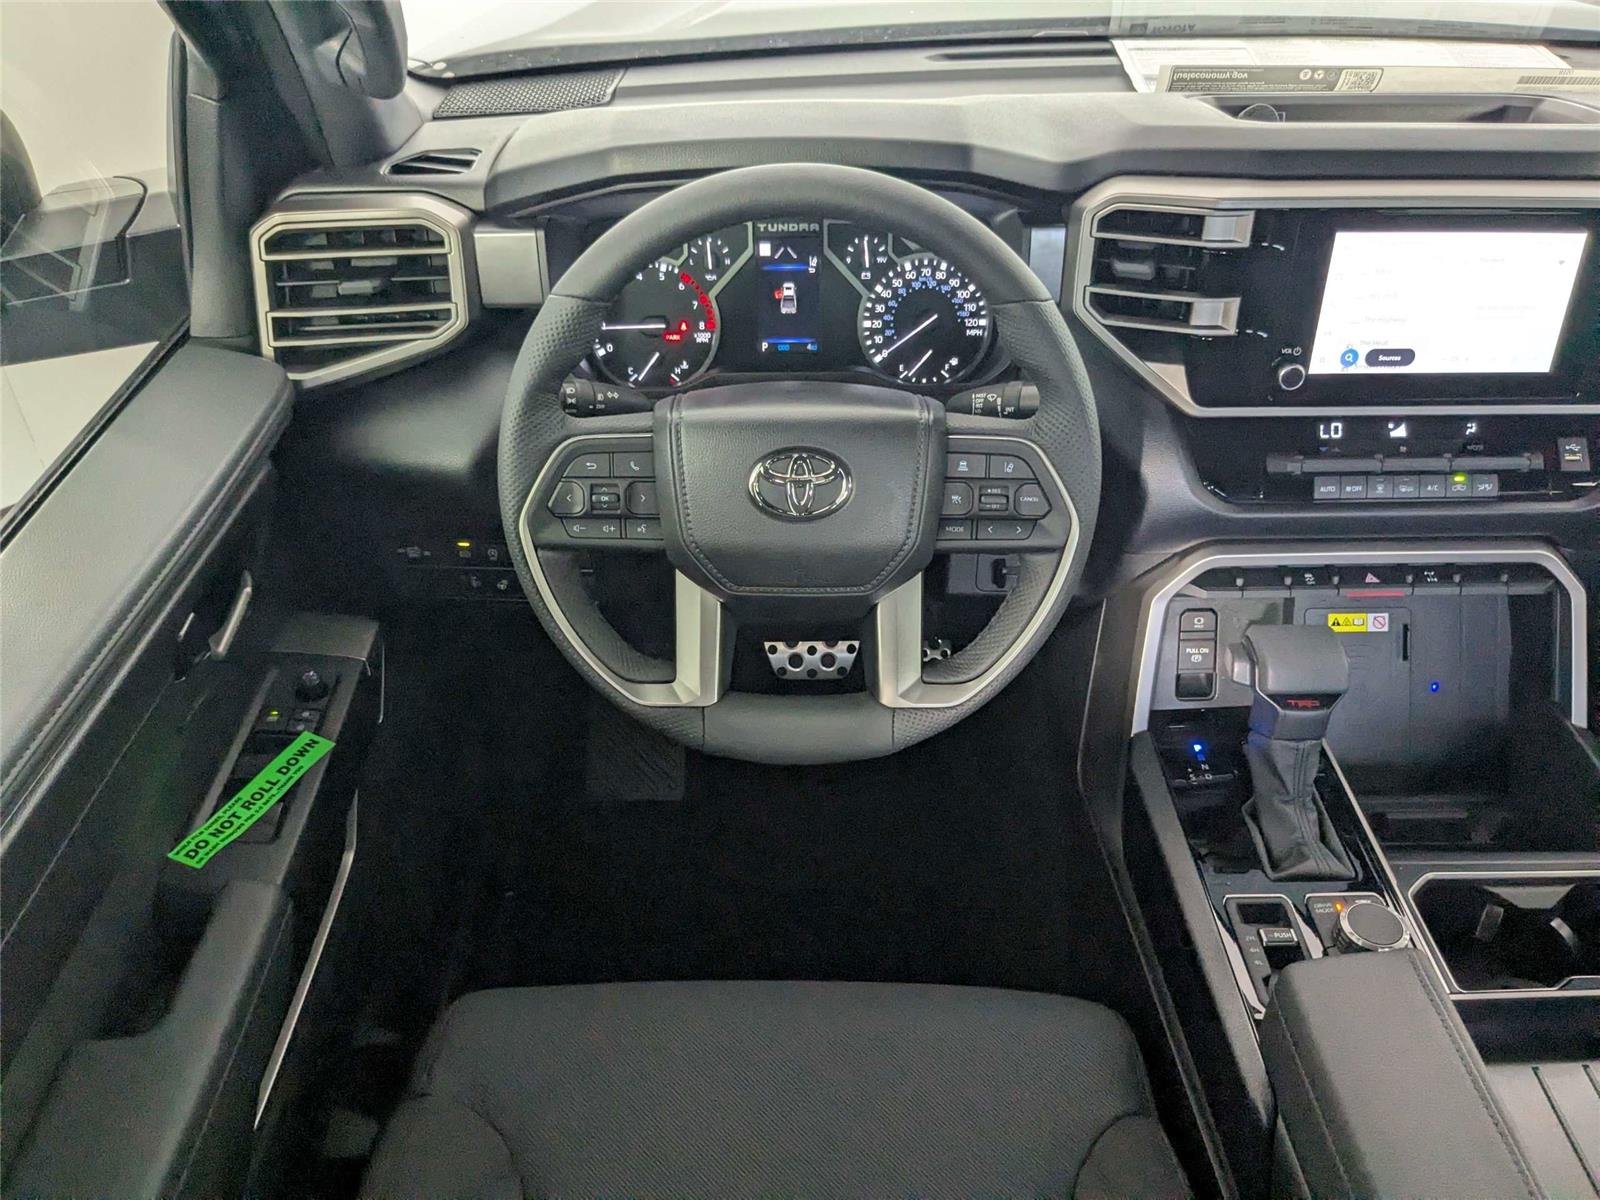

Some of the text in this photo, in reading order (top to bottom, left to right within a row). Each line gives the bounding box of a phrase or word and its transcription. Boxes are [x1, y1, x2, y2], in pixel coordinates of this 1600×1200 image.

[757, 222, 820, 232] TUNDRA
[636, 272, 643, 281] 4
[658, 272, 665, 281] 5
[905, 271, 916, 280] 60
[920, 268, 931, 277] 70
[935, 271, 946, 280] 80
[678, 282, 685, 291] 6
[892, 280, 902, 288] 50
[949, 280, 960, 288] 90
[881, 290, 892, 298] 40
[956, 290, 970, 298] 100
[692, 300, 698, 310] 7
[875, 304, 885, 313] 30
[964, 303, 976, 312] 110
[699, 321, 705, 330] 8
[872, 320, 882, 329] 20
[964, 319, 978, 327] 120
[874, 335, 883, 344] 10
[606, 343, 613, 353] 0
[761, 342, 768, 352] P
[1378, 354, 1401, 362] Sources
[628, 366, 634, 375] C
[675, 367, 681, 375] H
[899, 364, 904, 372] E
[945, 363, 950, 371] F
[1319, 422, 1343, 439] LO
[1319, 485, 1336, 493] AUTO
[183, 739, 320, 860] DO NOT ROLL DOWN
[1273, 931, 1292, 939] PUSH
